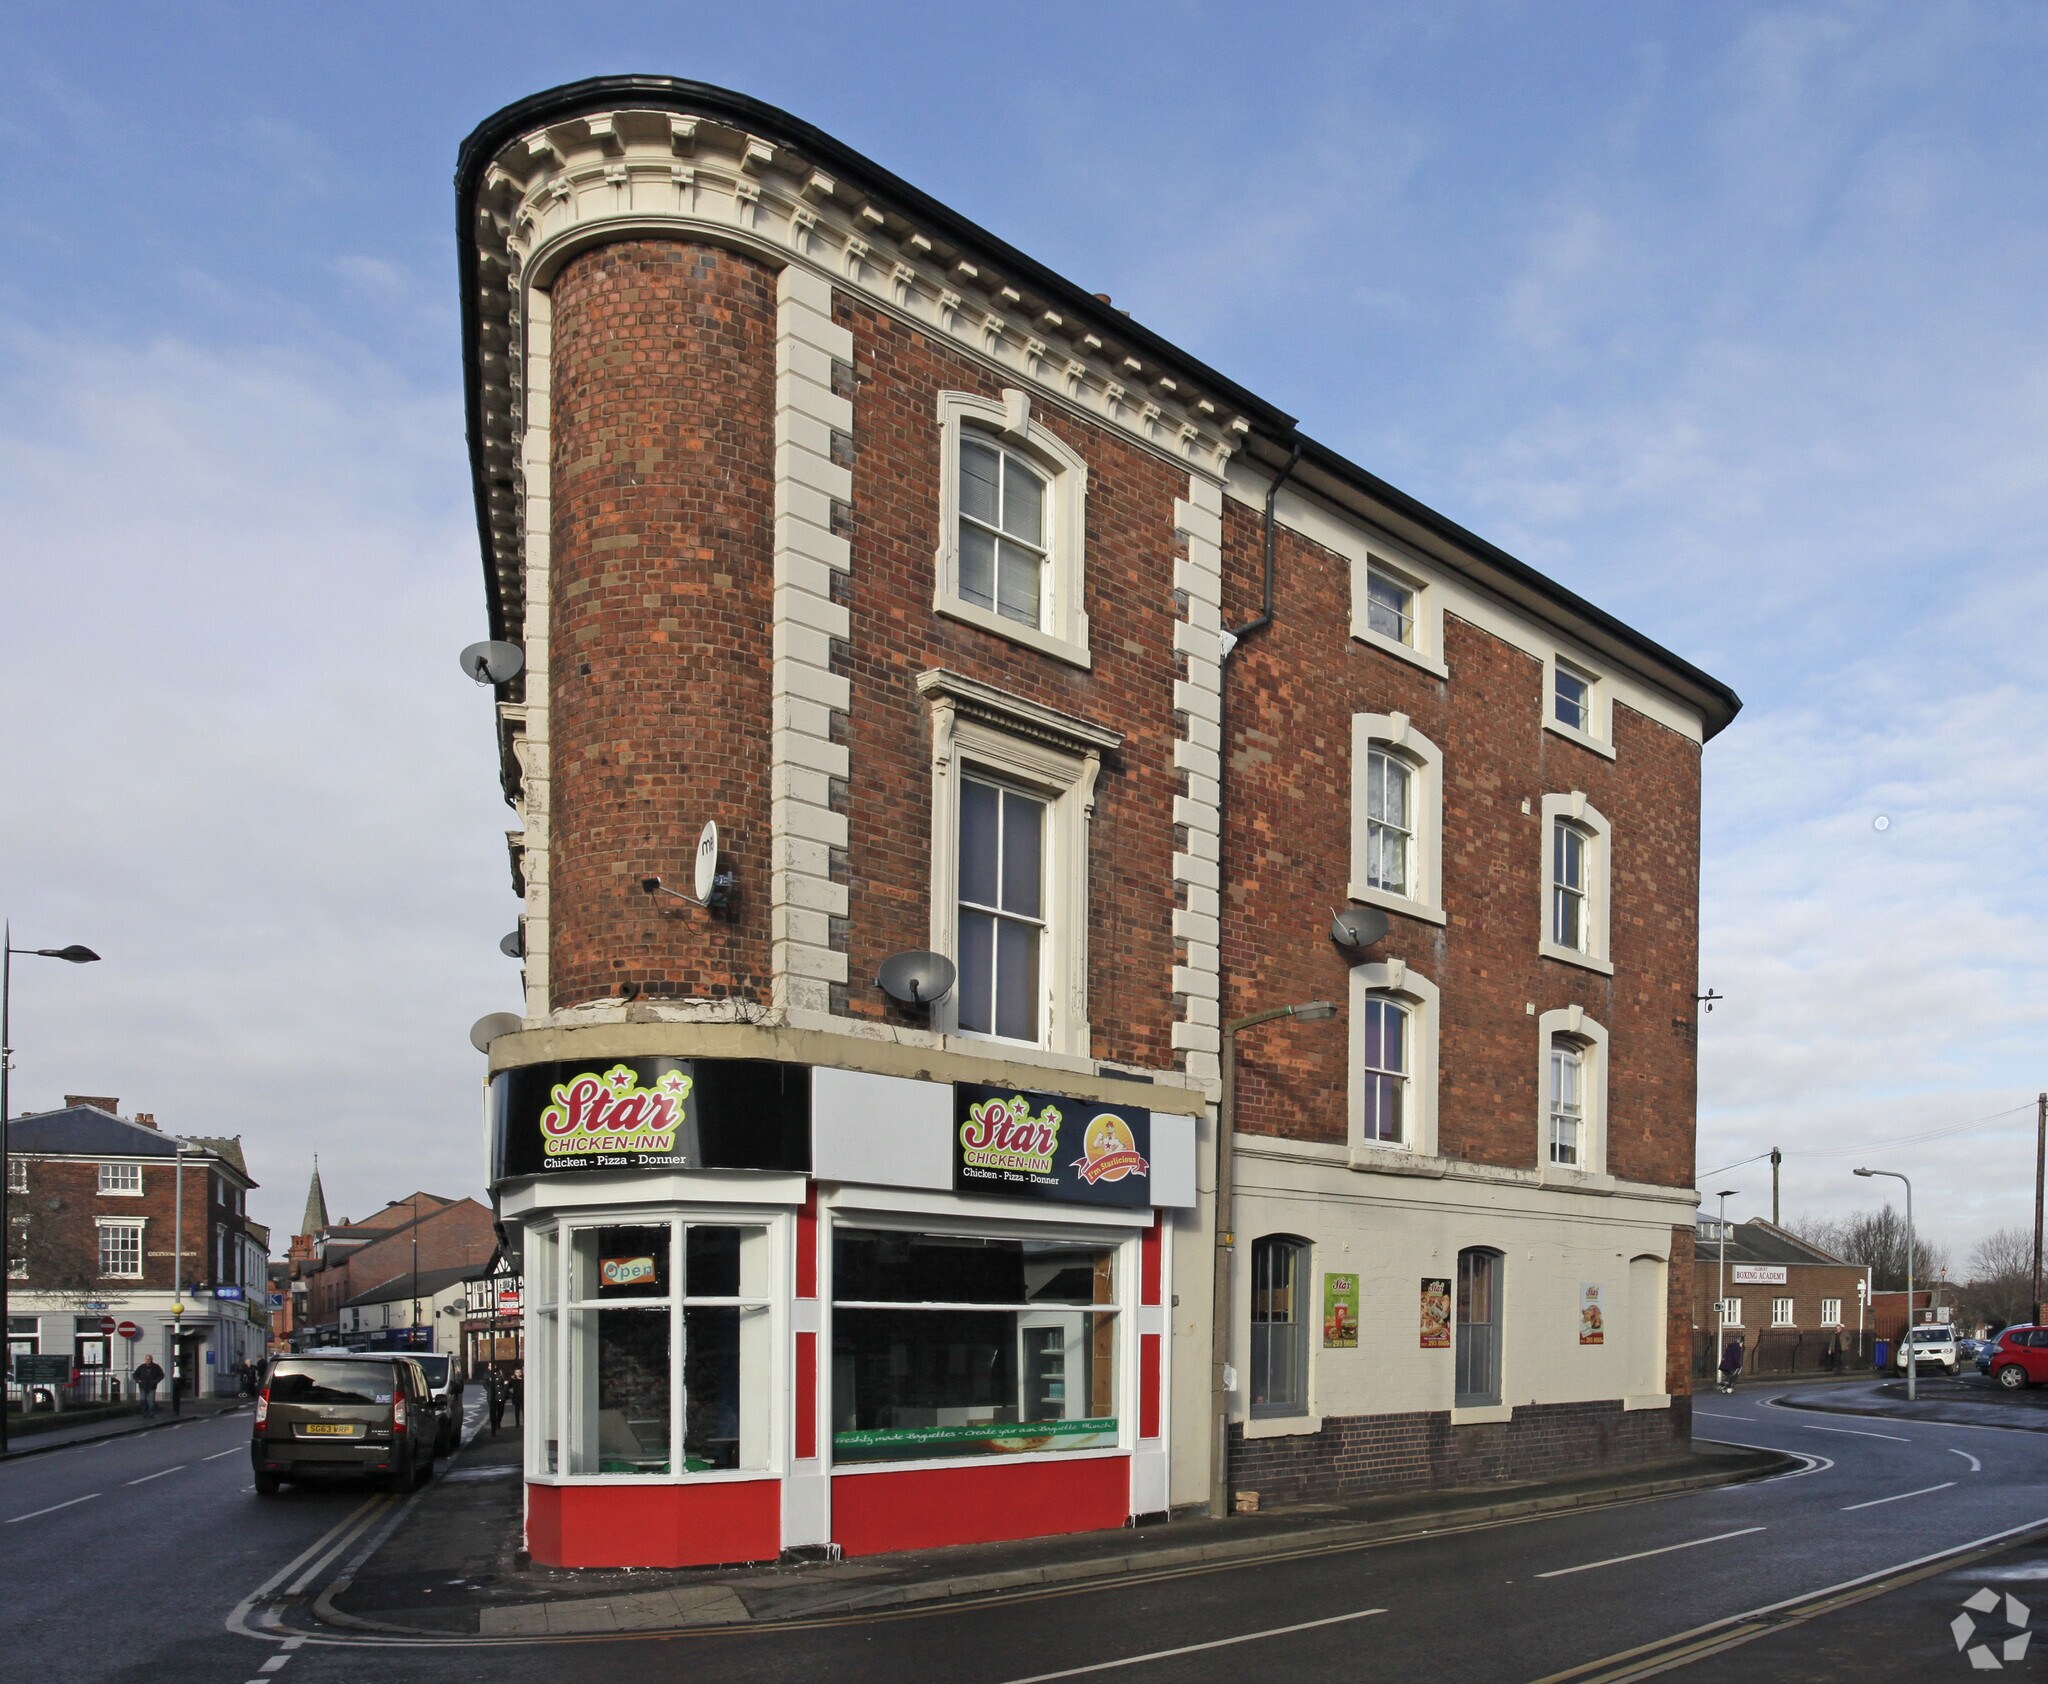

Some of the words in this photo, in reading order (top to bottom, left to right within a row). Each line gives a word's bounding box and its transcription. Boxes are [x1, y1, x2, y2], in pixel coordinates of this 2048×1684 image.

[545, 1079, 677, 1135] Star
[964, 1104, 1054, 1155] Star
[548, 1135, 670, 1153] CHICKEN-INN
[543, 1158, 587, 1169] Chicken
[597, 1155, 628, 1166] Pizza
[638, 1154, 687, 1165] Donner
[967, 1151, 1050, 1171] CHICKEN-INN
[1100, 1156, 1137, 1169] Starlicious
[963, 1167, 998, 1179] Chicken
[1003, 1171, 1024, 1182] Pizza
[1030, 1174, 1060, 1185] Donner
[605, 1265, 653, 1281] Open
[1737, 1271, 1758, 1280] BOXING
[1759, 1272, 1785, 1280] ACADEMY
[310, 1425, 332, 1433] SG63
[875, 1434, 904, 1442] made
[906, 1430, 956, 1443] Baguettes
[964, 1428, 997, 1437] Create
[998, 1428, 1016, 1437] your
[1038, 1425, 1078, 1434] Baguette
